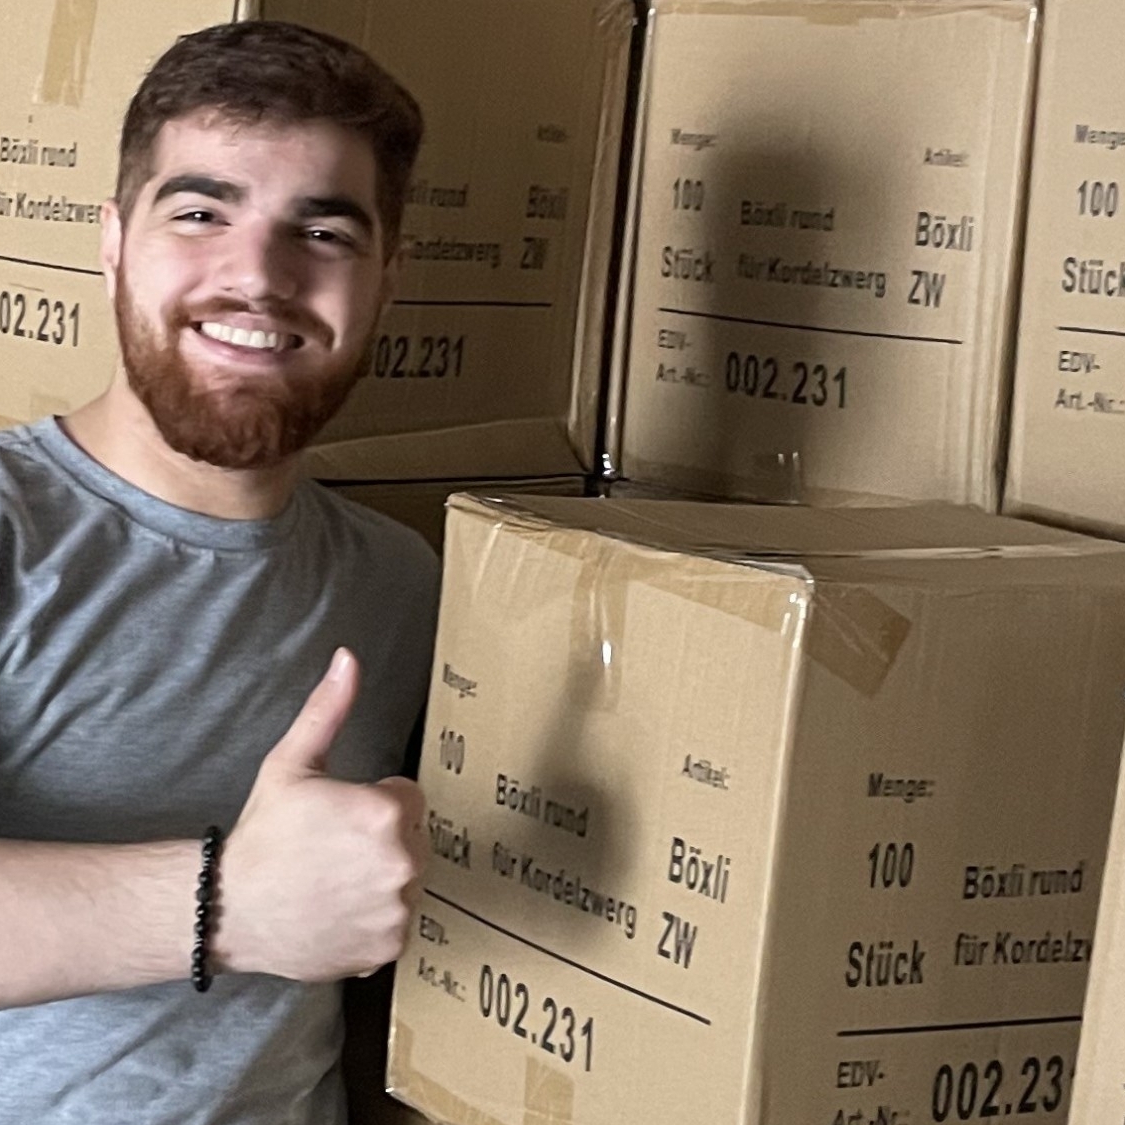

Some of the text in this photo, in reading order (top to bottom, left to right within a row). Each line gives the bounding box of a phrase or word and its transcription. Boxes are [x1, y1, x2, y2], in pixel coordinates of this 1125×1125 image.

[14, 192, 102, 224] Kordelzwer
[673, 178, 705, 212] 100
[1077, 179, 1119, 218] 100
[790, 206, 835, 233] rund
[916, 211, 974, 252] Böxli
[661, 246, 715, 285] Stück
[907, 270, 946, 308] ZW
[374, 335, 467, 379] 02.231
[725, 351, 848, 409] 002.231
[438, 726, 466, 775] 100
[495, 773, 591, 838] Böxli rund
[668, 836, 732, 903] Böxli
[867, 842, 915, 889] 100
[963, 860, 1084, 900] Böxli rund
[520, 858, 637, 939] Kordelzwerg
[656, 911, 699, 969] ZW
[954, 932, 988, 967] für
[845, 939, 926, 989] Stück
[478, 964, 594, 1072] 002.231
[836, 1059, 886, 1089] EDV-
[931, 1055, 1076, 1123] 002.23
